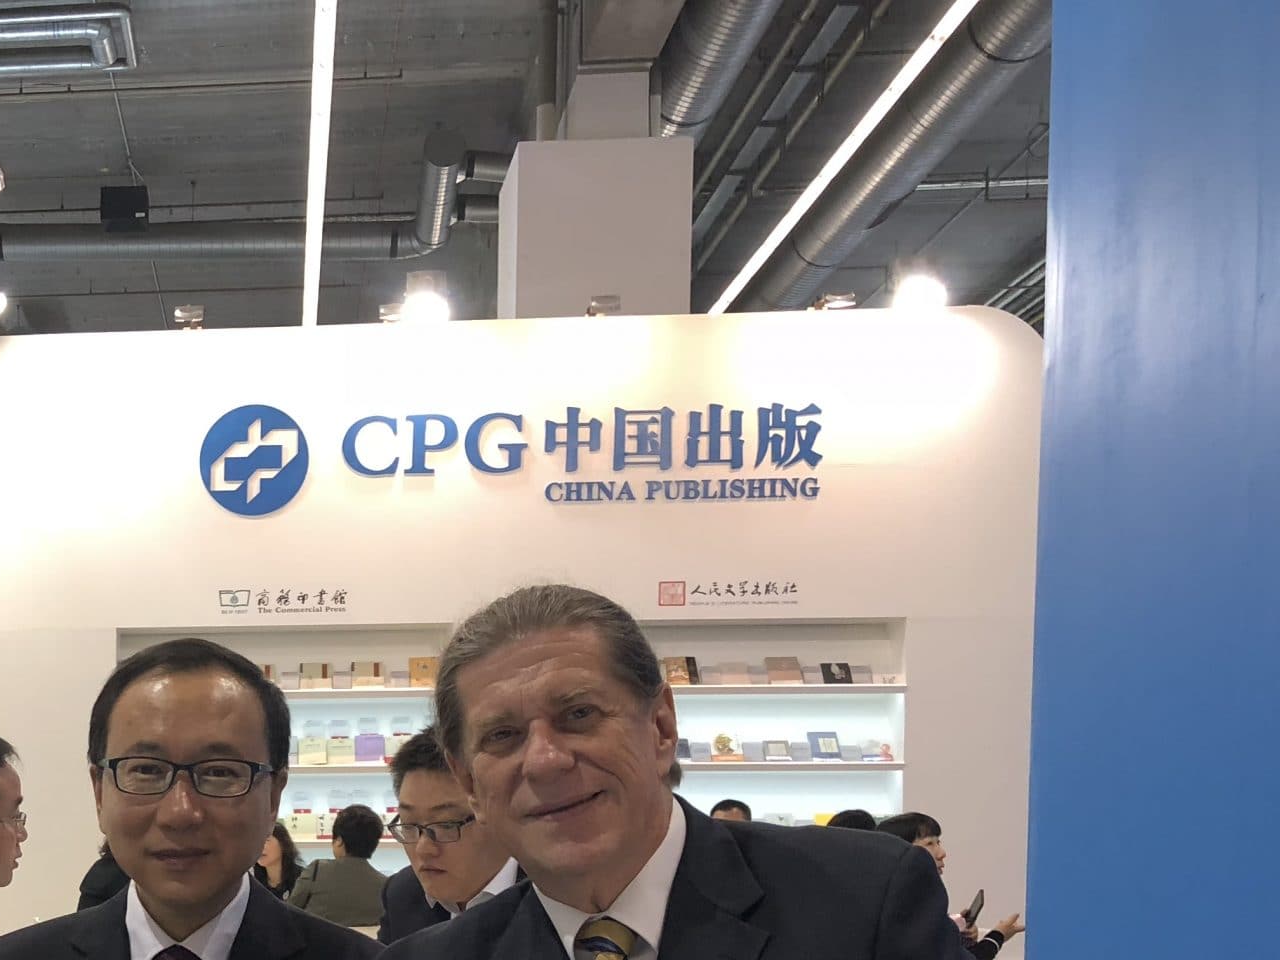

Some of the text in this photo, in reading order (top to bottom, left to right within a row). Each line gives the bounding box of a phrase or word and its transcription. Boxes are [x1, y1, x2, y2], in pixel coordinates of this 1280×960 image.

[341, 412, 528, 479] CPG
[544, 402, 824, 473] 中国出版
[545, 476, 820, 503] CHINA PUBLISHING
[275, 606, 322, 614] Commercial
